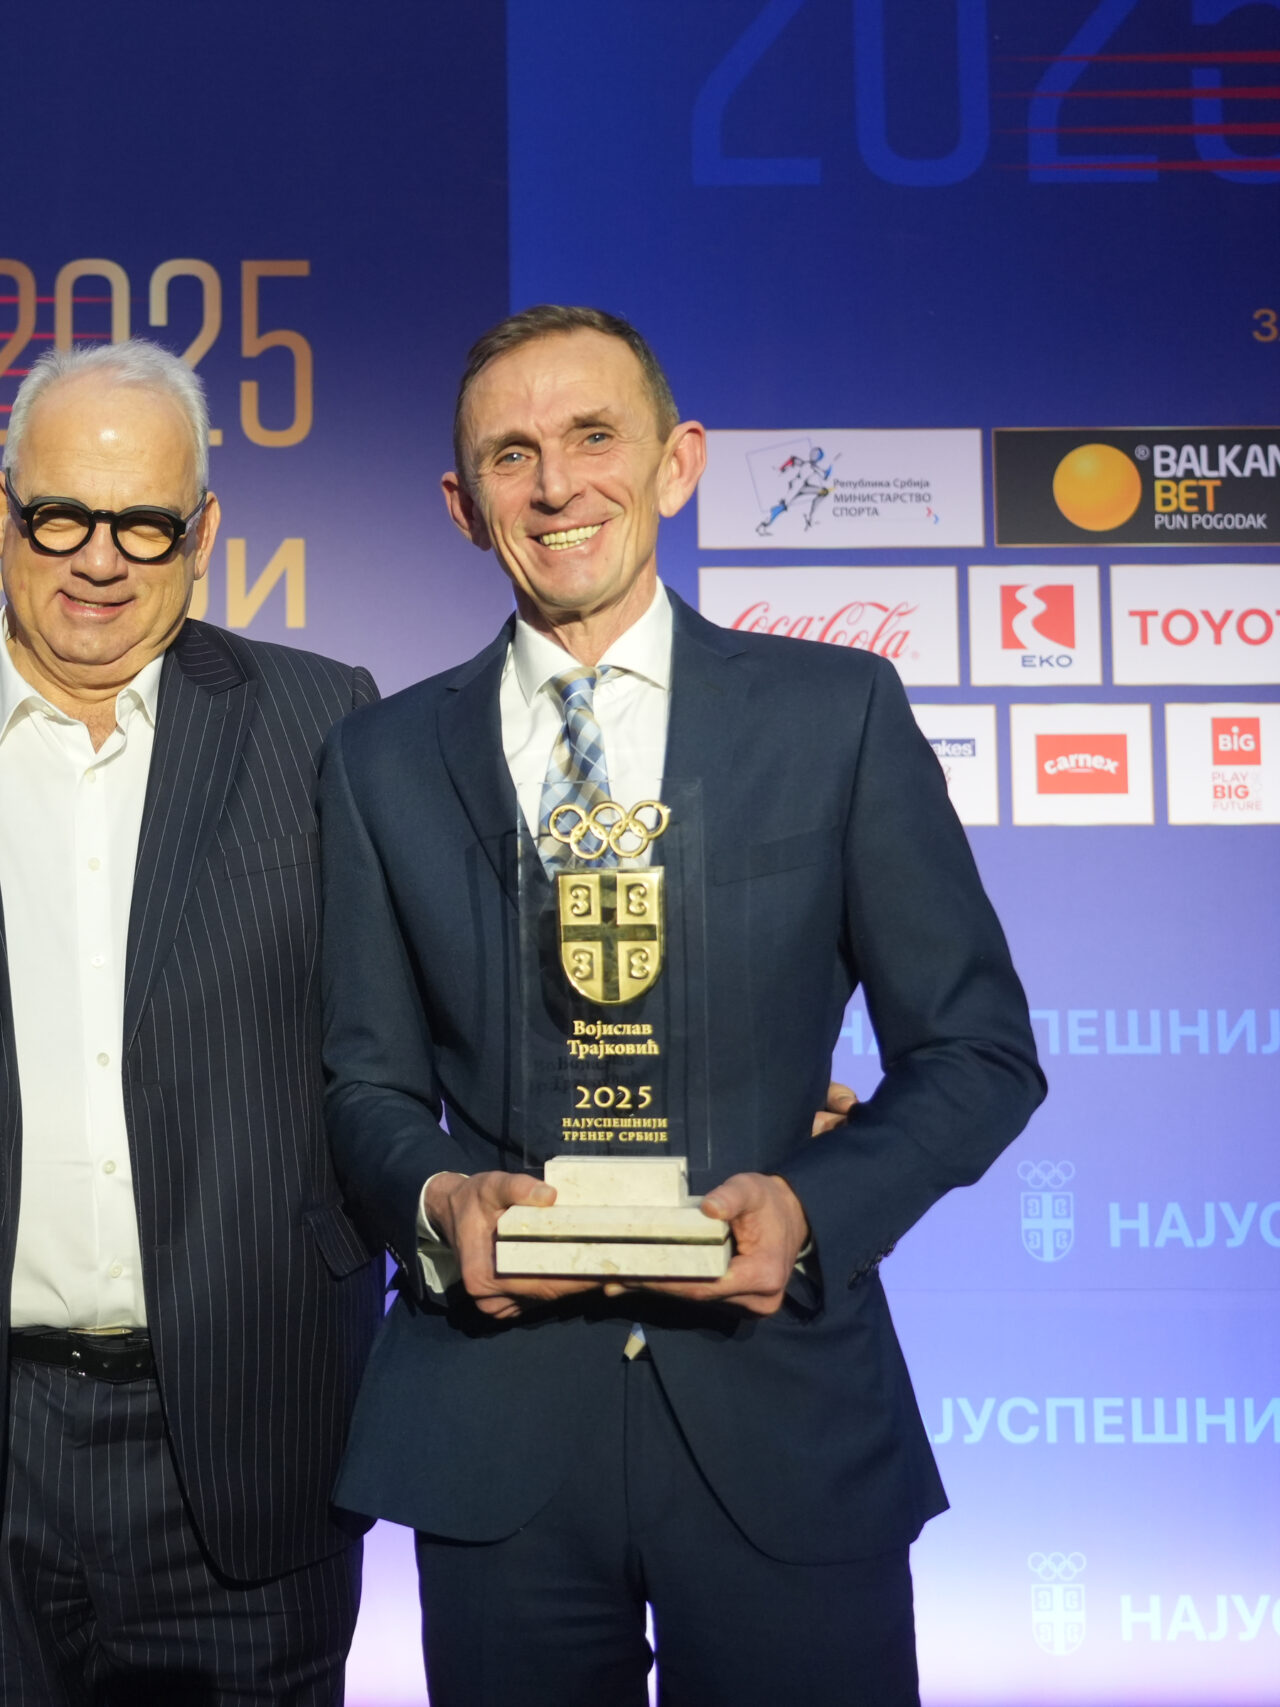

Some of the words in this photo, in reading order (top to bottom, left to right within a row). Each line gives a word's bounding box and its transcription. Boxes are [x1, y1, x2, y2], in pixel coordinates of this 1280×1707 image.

[833, 478, 890, 490] Република
[893, 478, 930, 490] Србија
[833, 493, 932, 504] МИНИСТАРСТВО
[1154, 480, 1222, 512] BET
[832, 507, 879, 517] СПОРТА
[1154, 514, 1189, 530] PUN
[1191, 513, 1268, 530] POGODAK
[1128, 608, 1280, 646] TOYO
[1021, 654, 1073, 668] EKO
[1044, 753, 1119, 775] carnex
[1211, 771, 1249, 783] PLAY
[1213, 784, 1250, 799] BIG
[1212, 800, 1263, 812] FUTURE
[573, 1020, 653, 1040] Војислав
[567, 1039, 660, 1059] Трајковић
[575, 1086, 653, 1109] 2025
[562, 1117, 668, 1129] НАЈУСПЕШНИЈИ
[562, 1131, 615, 1142] ТРЕНЕР
[618, 1131, 668, 1143] СРБИЈЕ
[1119, 1594, 1280, 1643] НАЈУ
